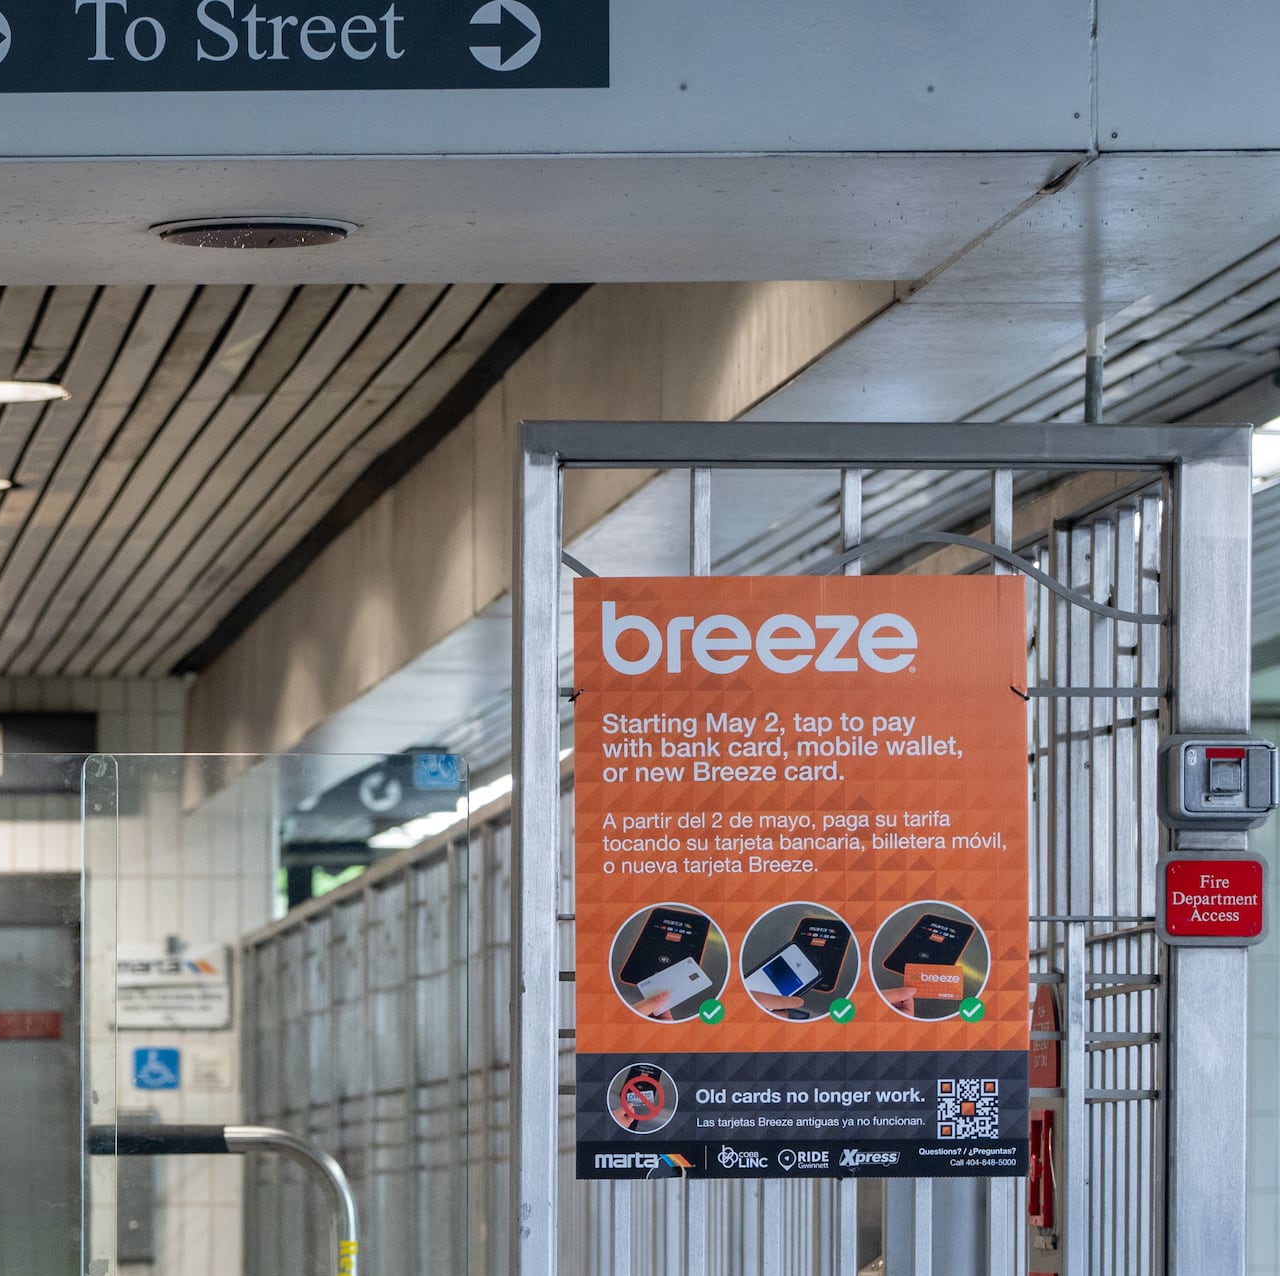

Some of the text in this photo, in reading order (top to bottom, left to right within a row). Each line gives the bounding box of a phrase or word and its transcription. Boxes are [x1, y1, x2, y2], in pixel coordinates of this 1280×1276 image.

[74, 0, 406, 63] To Street
[601, 600, 919, 676] breeze
[602, 712, 917, 738] Starting May 2, tap to pay
[602, 735, 964, 761] with bank card, mobile wallet,
[602, 760, 845, 783] or new Breeze card.
[602, 810, 951, 834] A partir del 2 de mayo, paga su tarifa
[602, 831, 1007, 856] tocando su tarjeta bancaria, billetera móvil,
[602, 856, 818, 876] o nueva tarjeta Breeze.
[1200, 875, 1230, 889] Fire
[1172, 891, 1258, 909] Department
[1191, 908, 1240, 923] Access
[920, 972, 961, 984] breeze
[695, 1088, 926, 1107] Old cards no longer work.
[696, 1115, 926, 1129] Las tarjetas Breeze antiguas ya no funcionan.
[797, 1151, 829, 1162] RIDE
[840, 1149, 897, 1167] Xpress
[918, 1147, 962, 1156] Questions?
[595, 1153, 660, 1169] marta
[738, 1158, 768, 1168] LINC
[950, 1158, 1017, 1167] Call 404-848-5000
